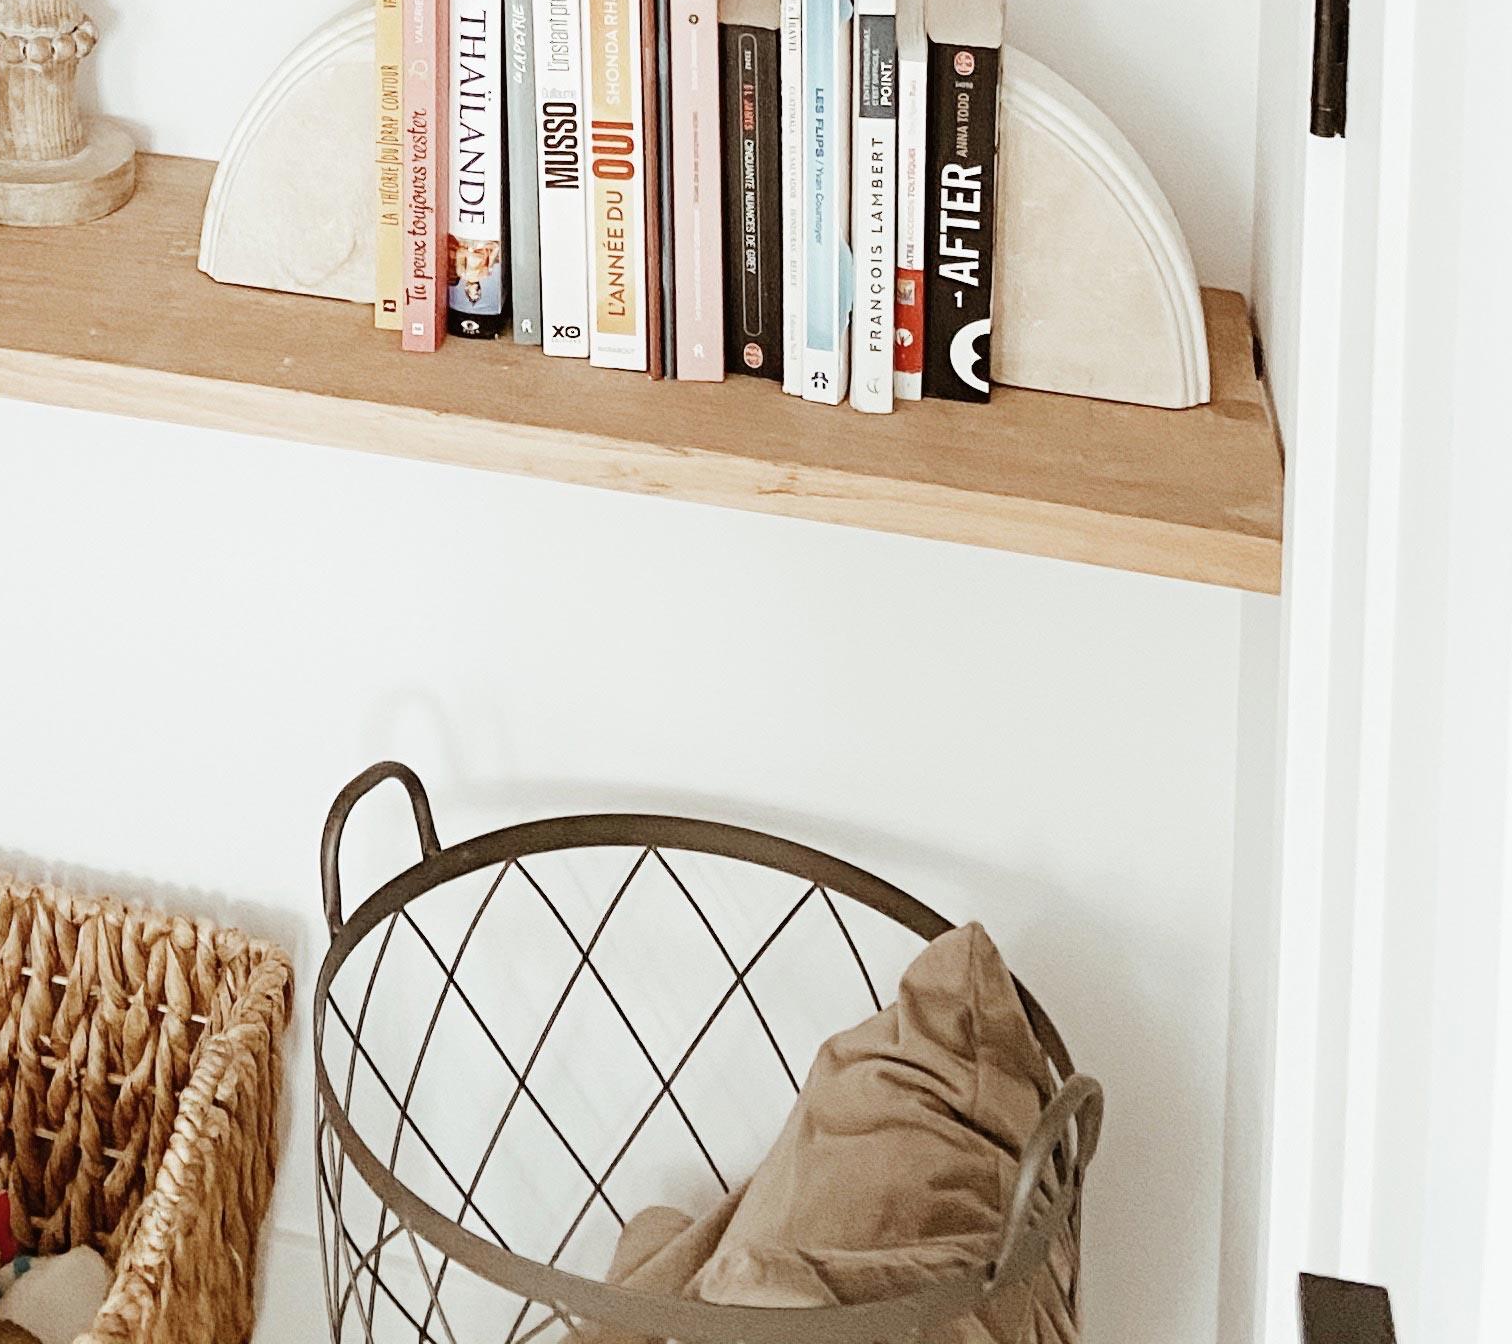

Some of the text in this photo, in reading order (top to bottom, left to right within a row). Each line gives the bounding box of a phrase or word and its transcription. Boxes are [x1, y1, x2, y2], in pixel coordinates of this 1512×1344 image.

[512, 4, 528, 73] LAPEYRIE
[548, 18, 570, 72] L'instant
[380, 65, 399, 111] CONTOUR
[605, 30, 620, 105] SHONDA
[459, 10, 491, 225] THAÏLANDE
[815, 87, 824, 114] LES
[957, 92, 970, 123] TODD
[407, 107, 429, 163] rester
[542, 102, 579, 189] MUSSO
[591, 120, 635, 180] OUI
[815, 118, 825, 158] FLIPS
[956, 125, 969, 159] ANNA
[408, 165, 433, 236] toujours
[816, 166, 825, 191] Yvan
[380, 212, 399, 226] LA
[744, 139, 757, 275] CINQUANTE NUANCES DE GREY
[938, 163, 983, 288] AFTER
[412, 240, 433, 280] peux
[603, 190, 625, 317] L'ANNÉE DU
[870, 137, 886, 352] FRANÇOIS LAMBERT
[406, 286, 427, 306] Tu
[953, 290, 964, 308] 1
[552, 325, 581, 339] XO
